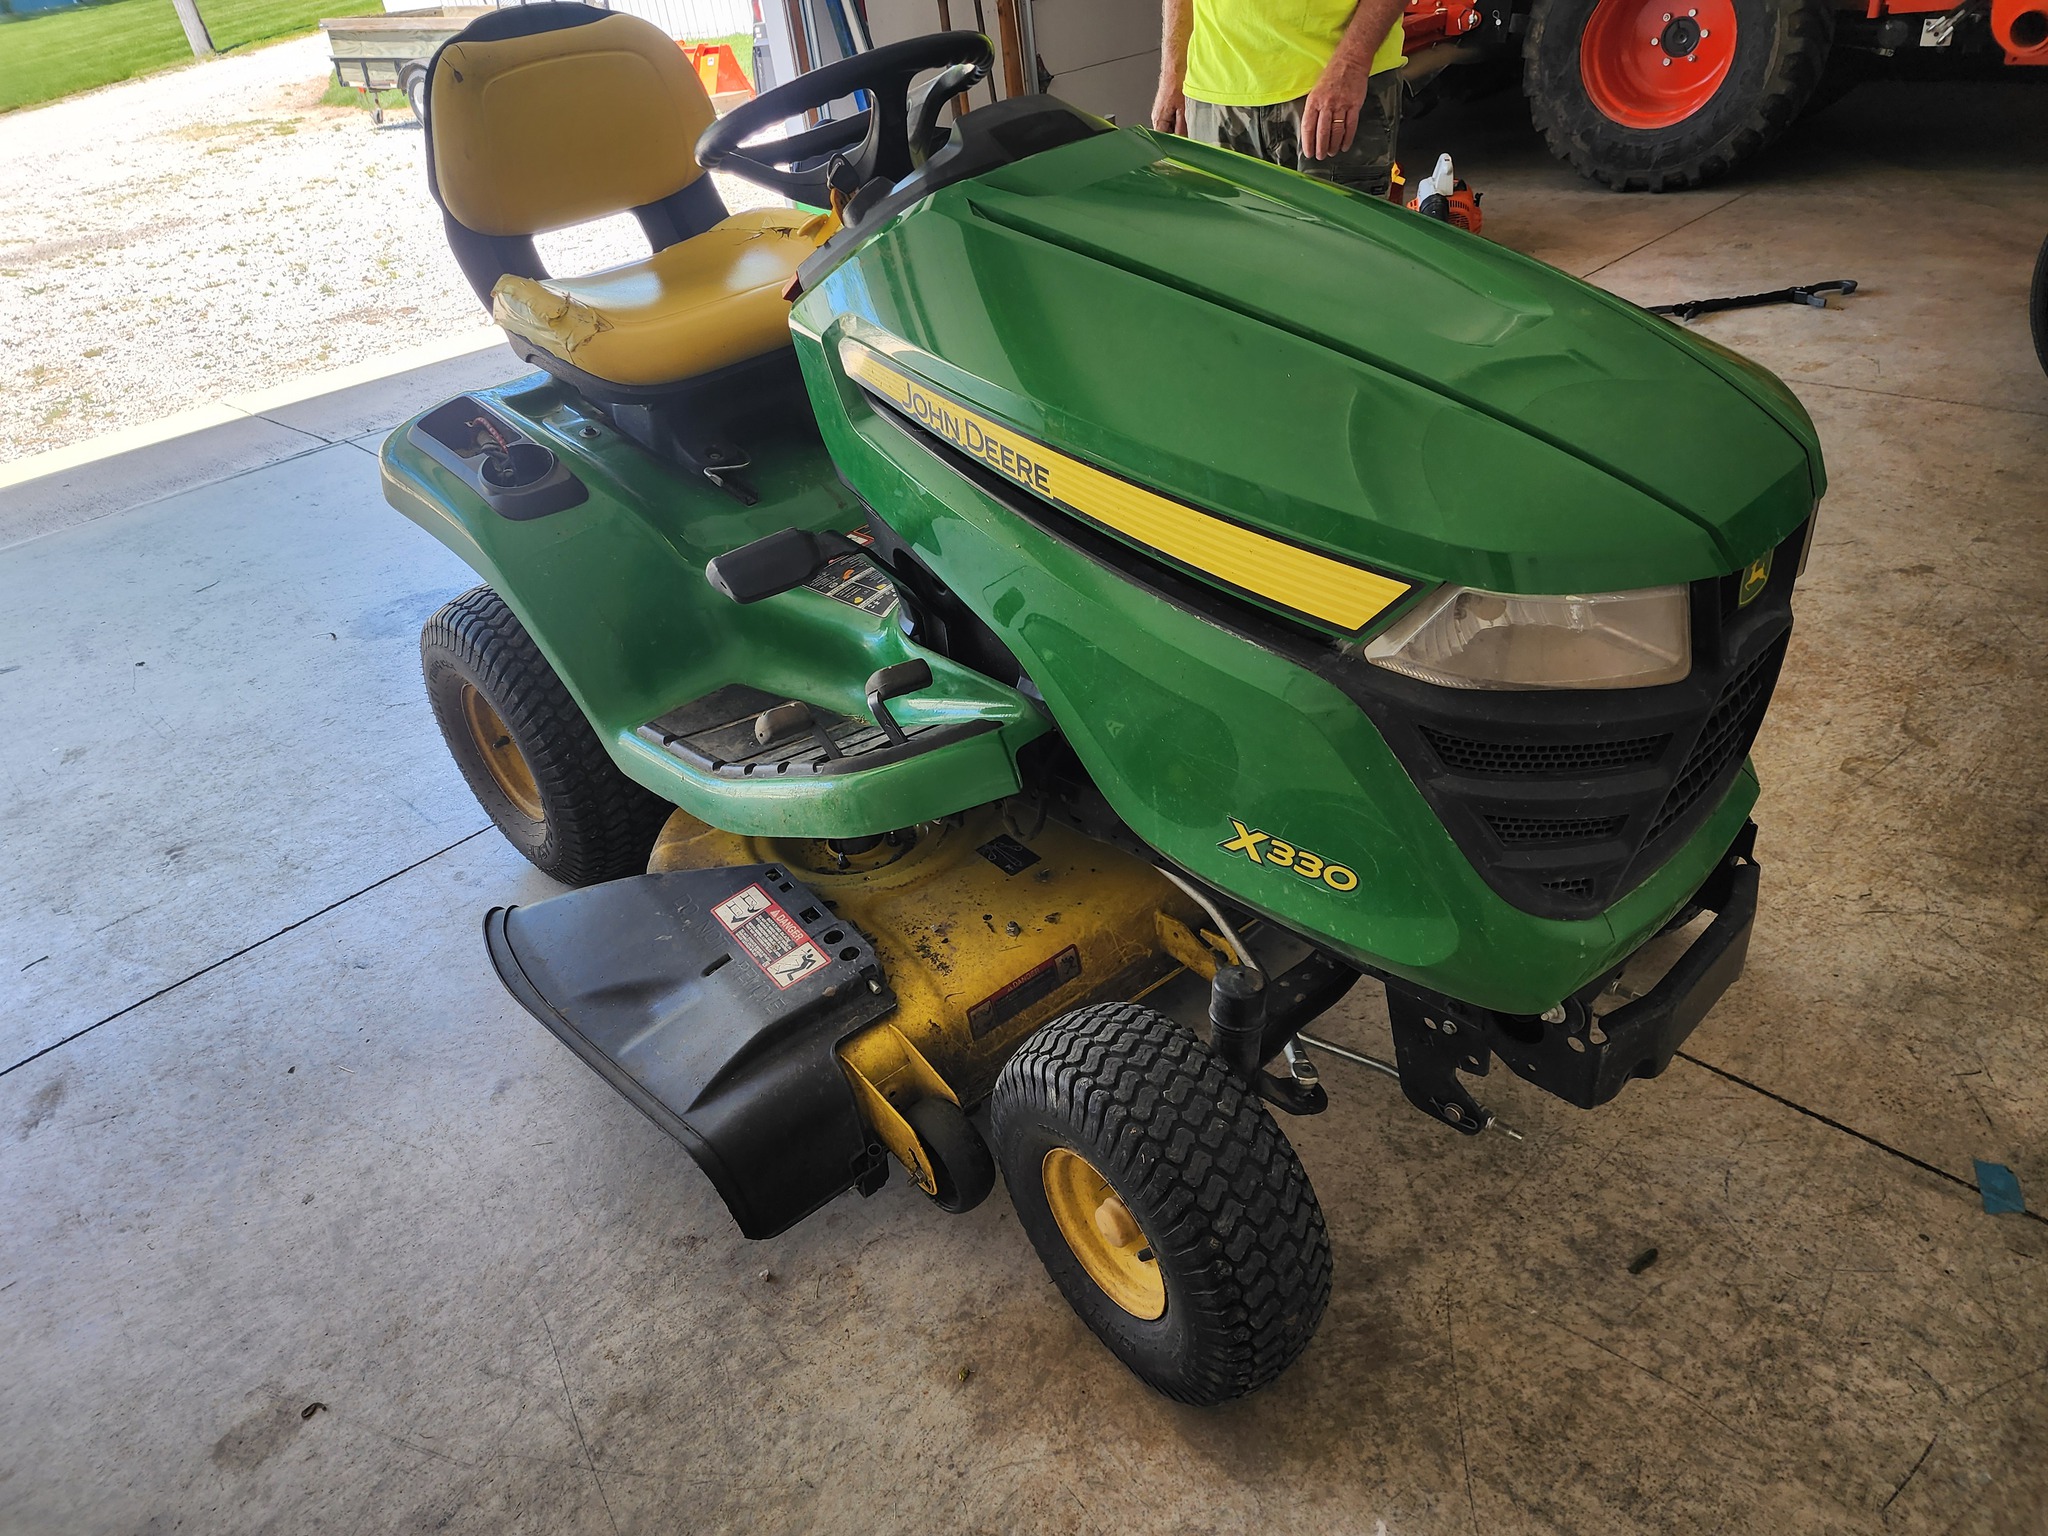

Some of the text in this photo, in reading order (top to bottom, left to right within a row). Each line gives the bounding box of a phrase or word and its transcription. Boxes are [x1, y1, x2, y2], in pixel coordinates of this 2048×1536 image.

[901, 382, 1051, 496] JOHN DEERE
[1222, 820, 1358, 892] X330
[775, 914, 804, 941] DANGER
[1012, 967, 1041, 988] DANGER
